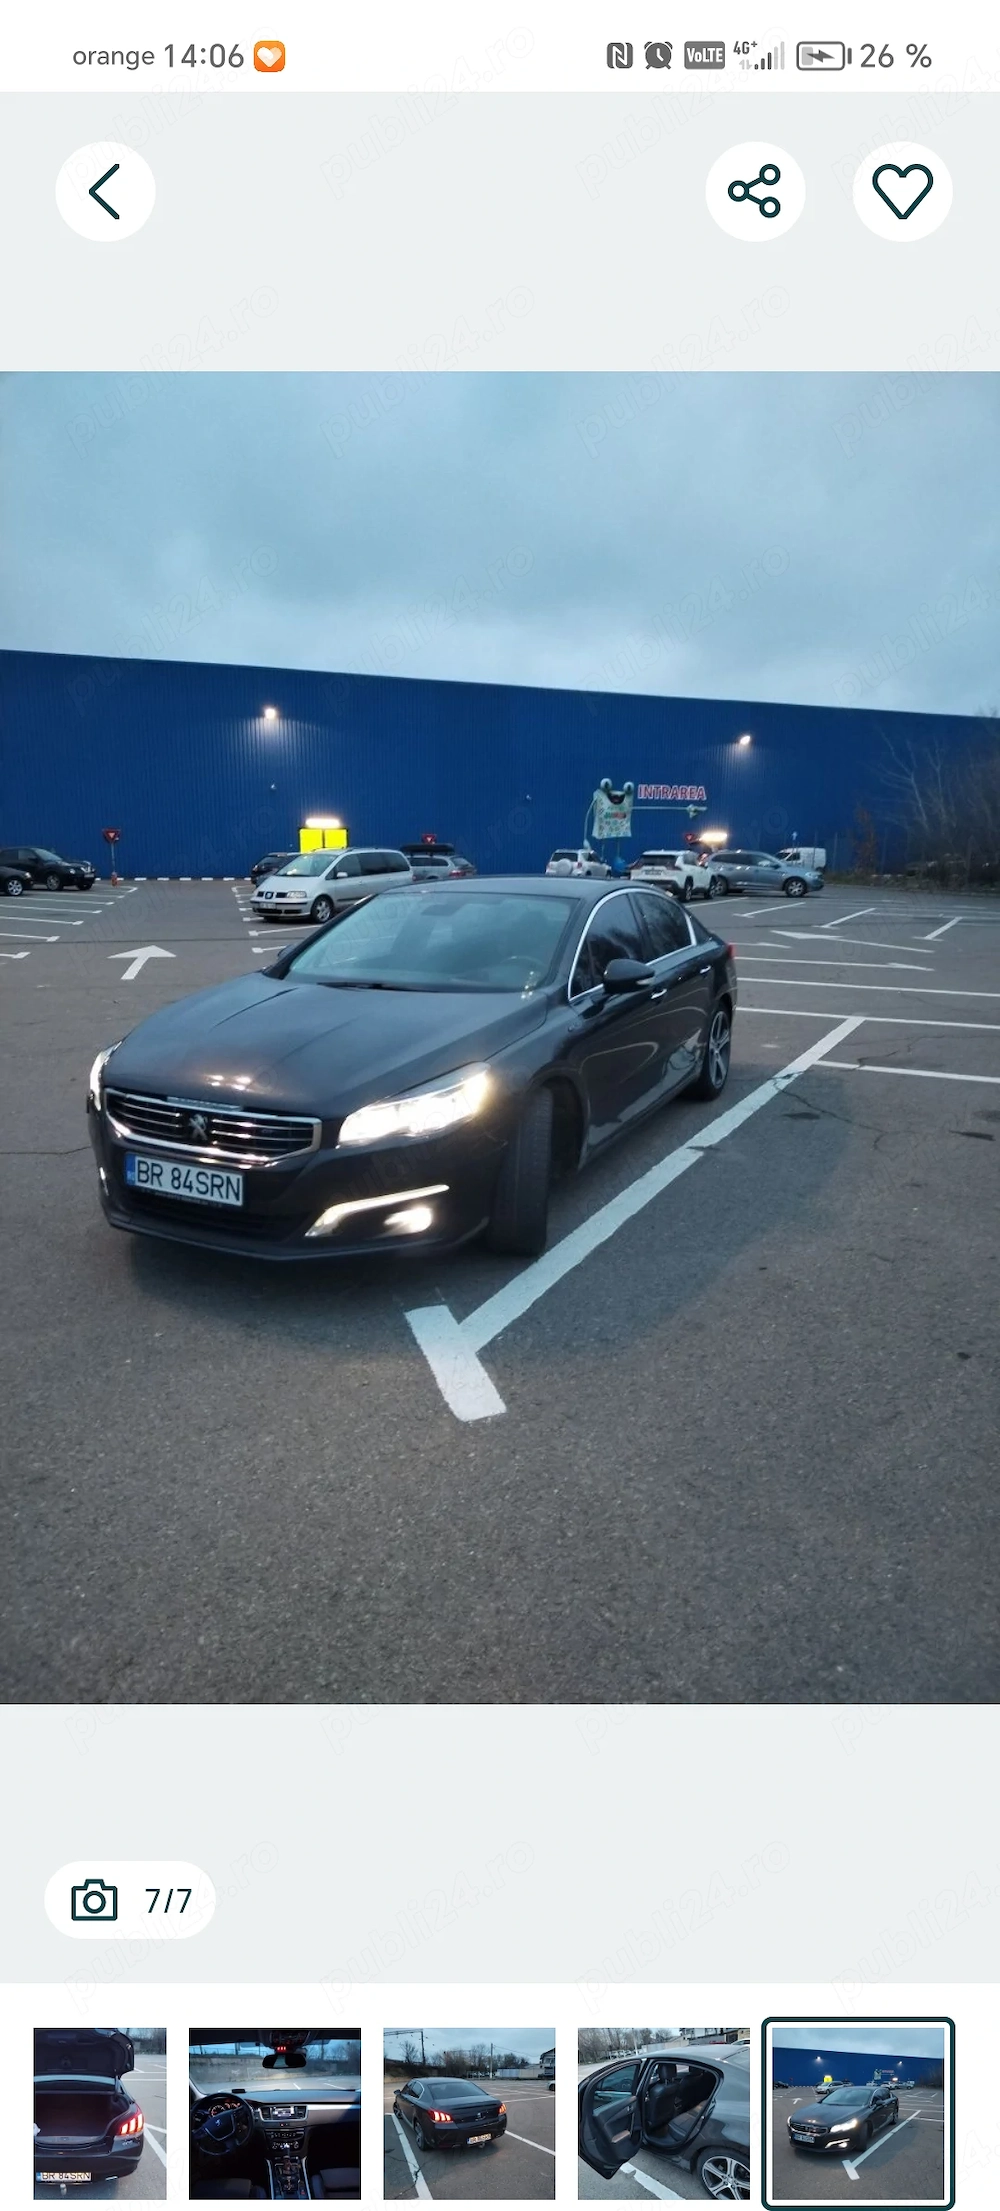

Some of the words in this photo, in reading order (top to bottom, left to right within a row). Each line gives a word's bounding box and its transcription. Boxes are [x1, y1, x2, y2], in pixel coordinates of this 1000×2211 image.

[73, 51, 154, 70] orange
[165, 44, 244, 68] 14:06
[687, 48, 723, 63] VoLTE
[861, 44, 894, 68] 26
[906, 44, 931, 68] %
[638, 784, 706, 800] INTRAREA
[138, 1160, 163, 1186] BR
[171, 1168, 239, 1201] 84SRN
[145, 1888, 192, 1914] 7/7
